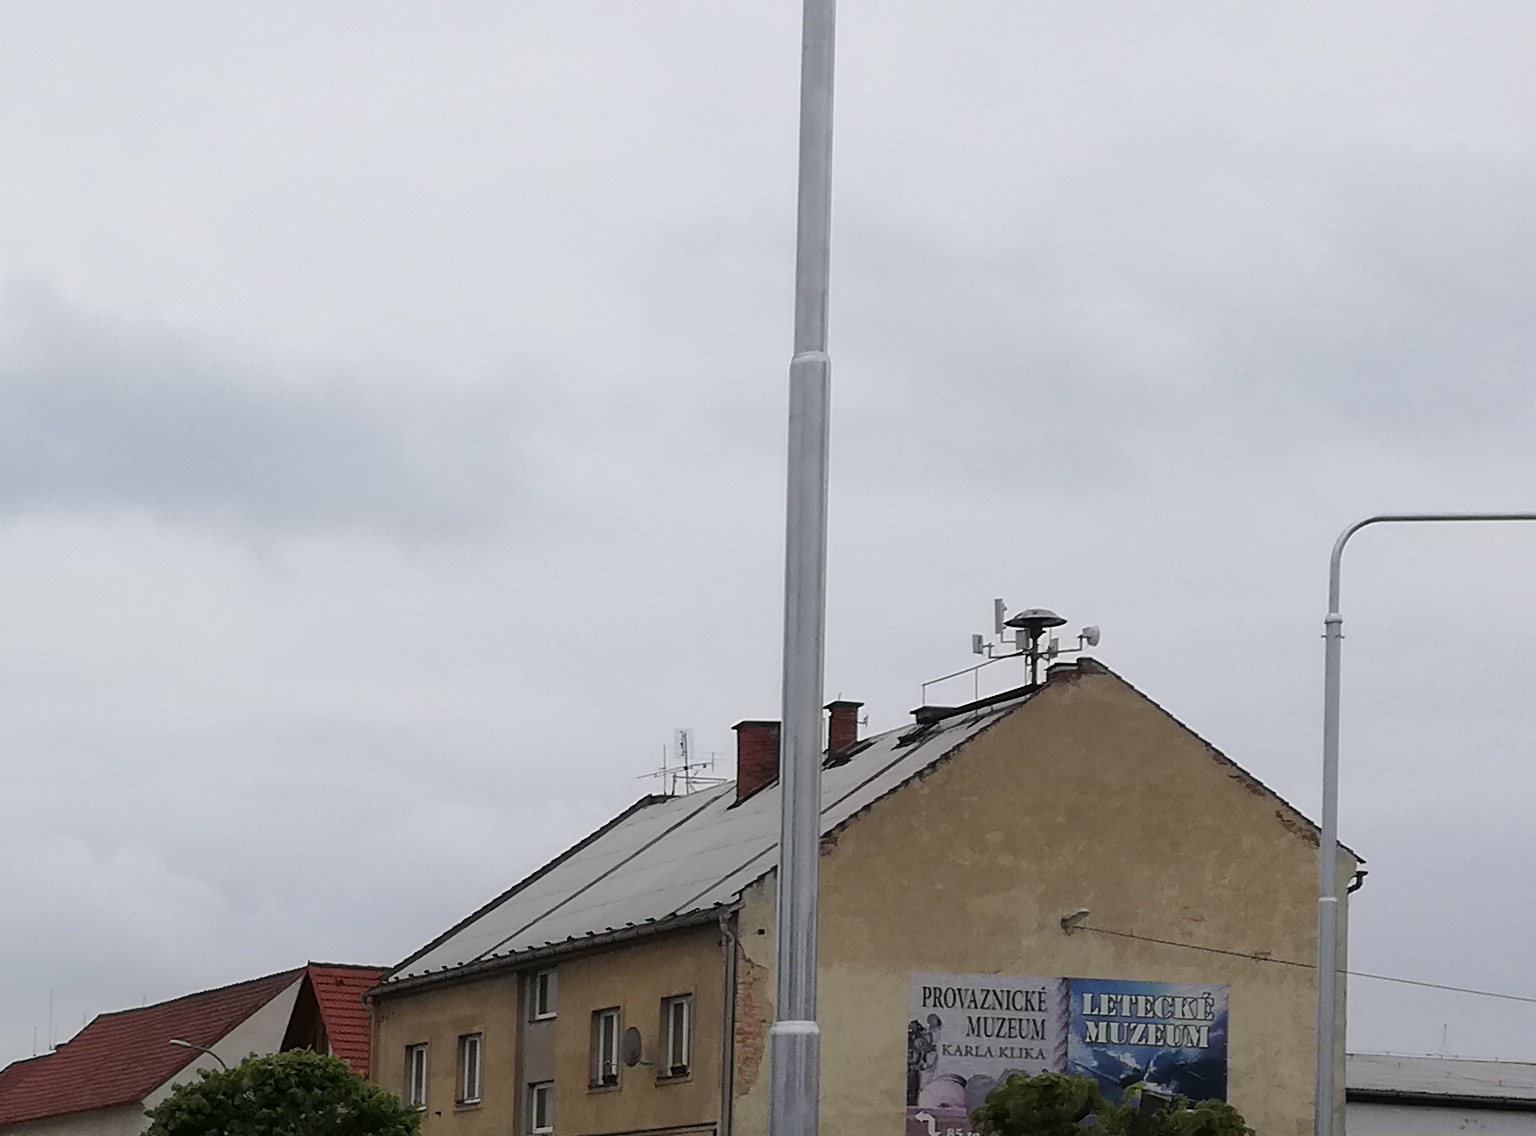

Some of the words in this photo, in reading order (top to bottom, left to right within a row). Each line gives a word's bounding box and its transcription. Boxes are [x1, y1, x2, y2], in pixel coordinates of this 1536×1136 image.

[921, 986, 1048, 1013] PROVAZNICKÉ
[1082, 991, 1215, 1021] LETECKÉ
[965, 1015, 1047, 1041] MUZEUM
[1084, 1020, 1210, 1048] MUZEUM
[942, 1043, 995, 1059] KARLA
[998, 1046, 1047, 1061] KLIKA
